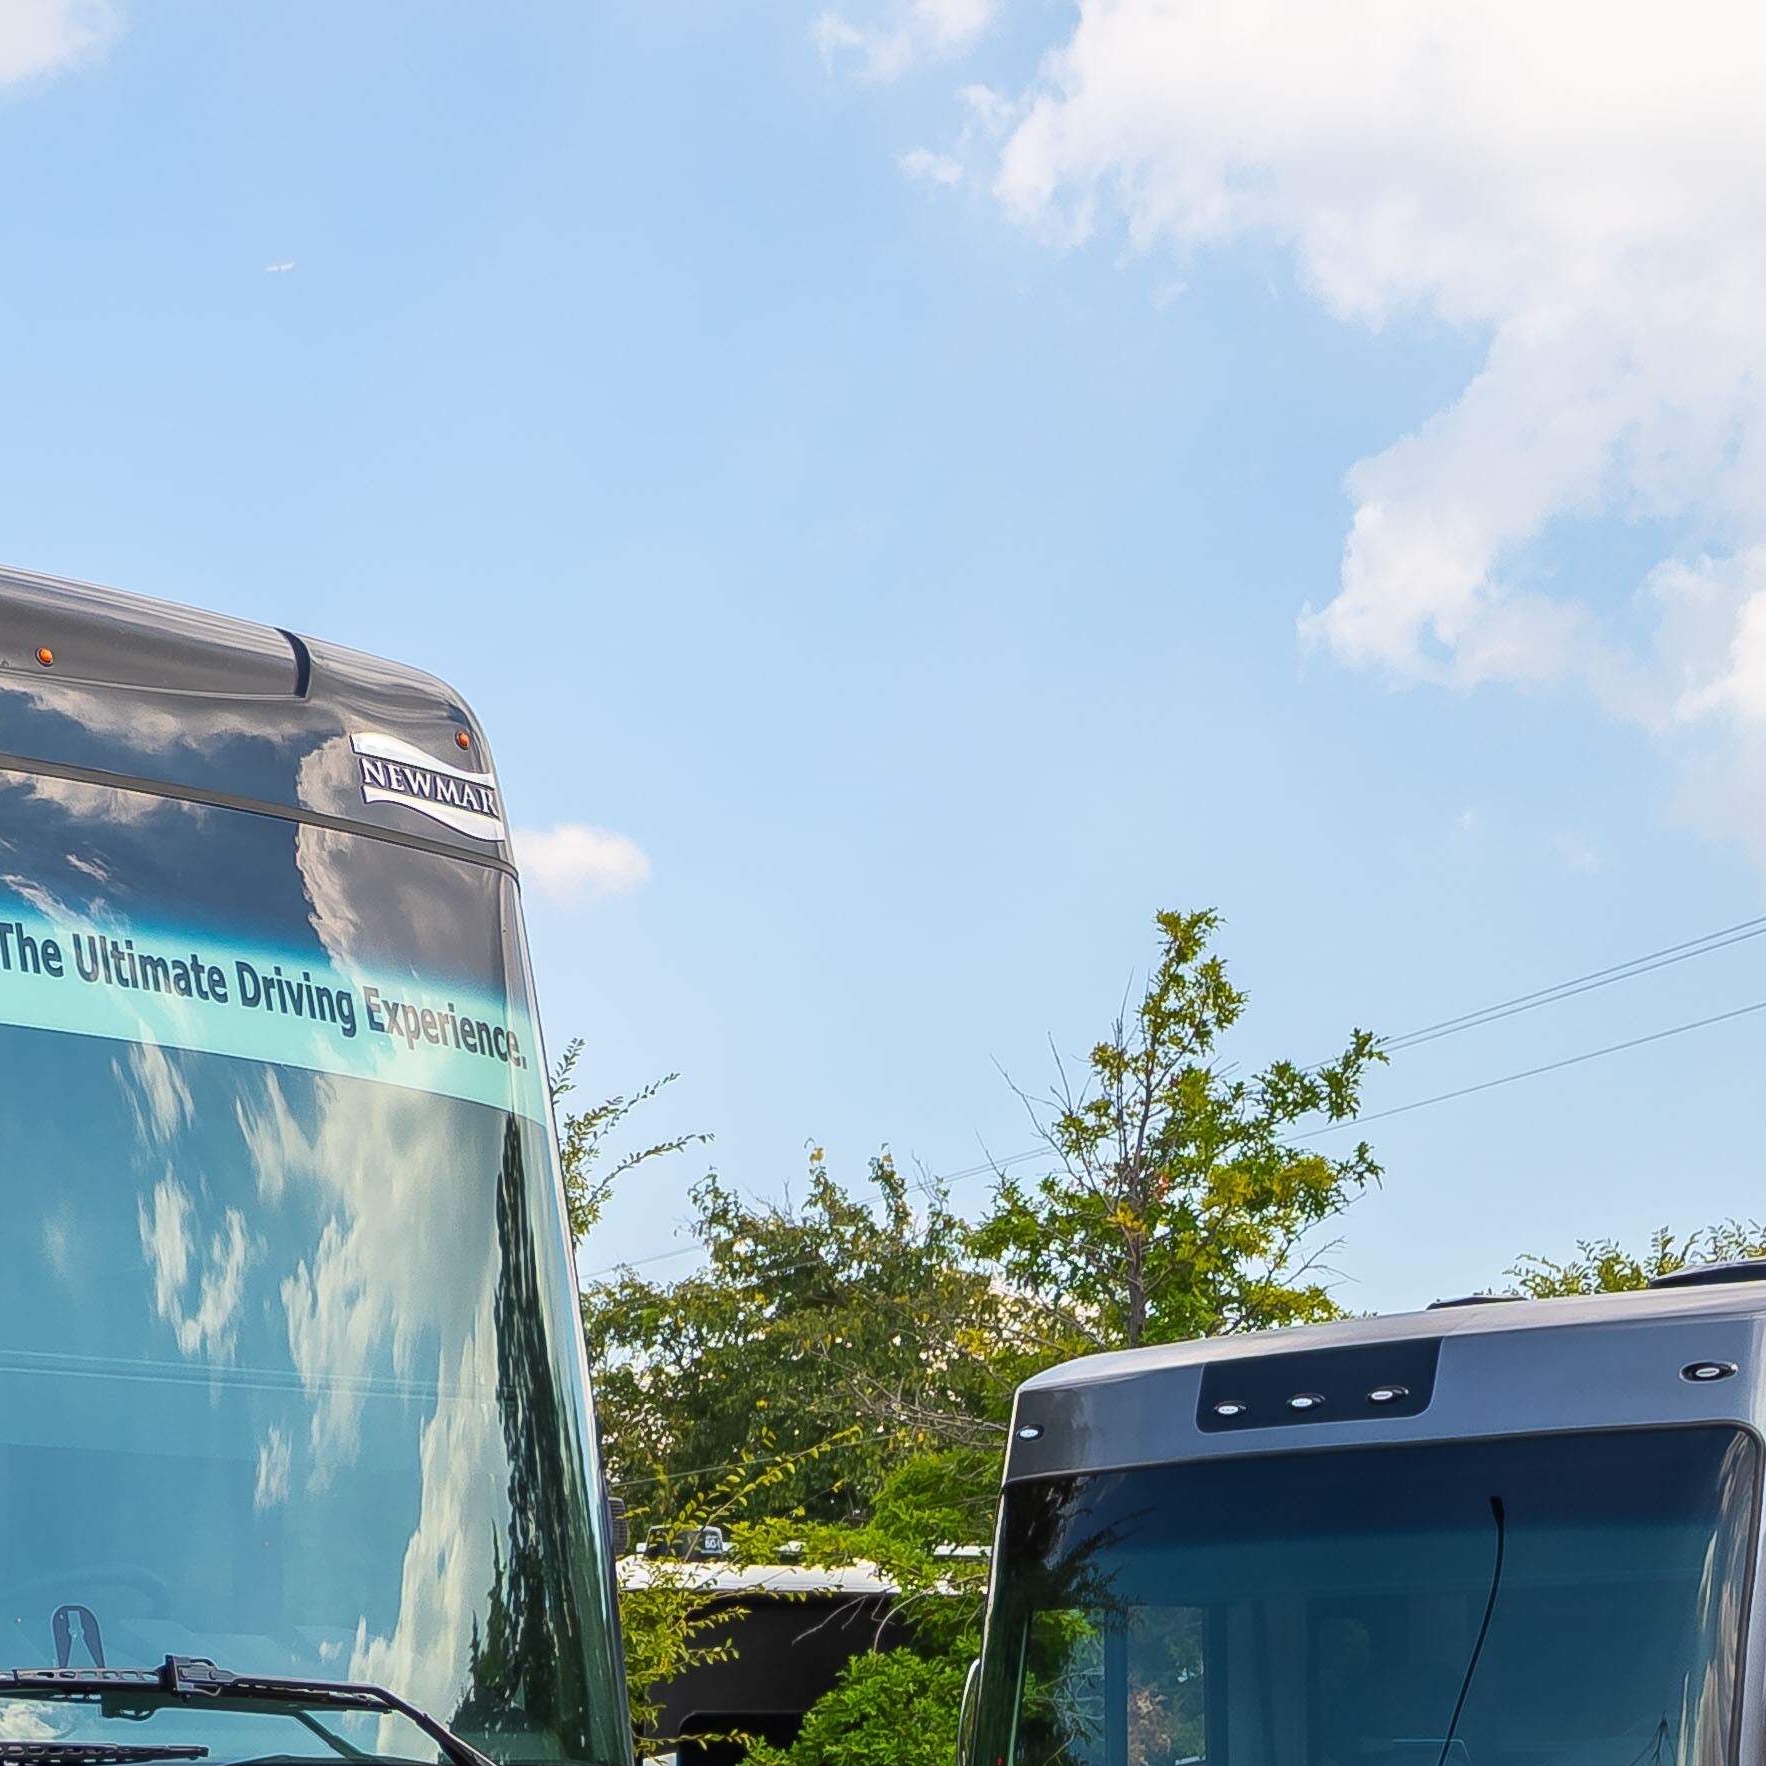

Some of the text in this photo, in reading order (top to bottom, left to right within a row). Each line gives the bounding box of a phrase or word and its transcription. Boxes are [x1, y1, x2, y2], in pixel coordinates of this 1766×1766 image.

[360, 757, 501, 820] NEWMAR
[72, 933, 229, 1004] Ultimate
[234, 960, 357, 1038] Driving
[363, 985, 528, 1070] Experience.
